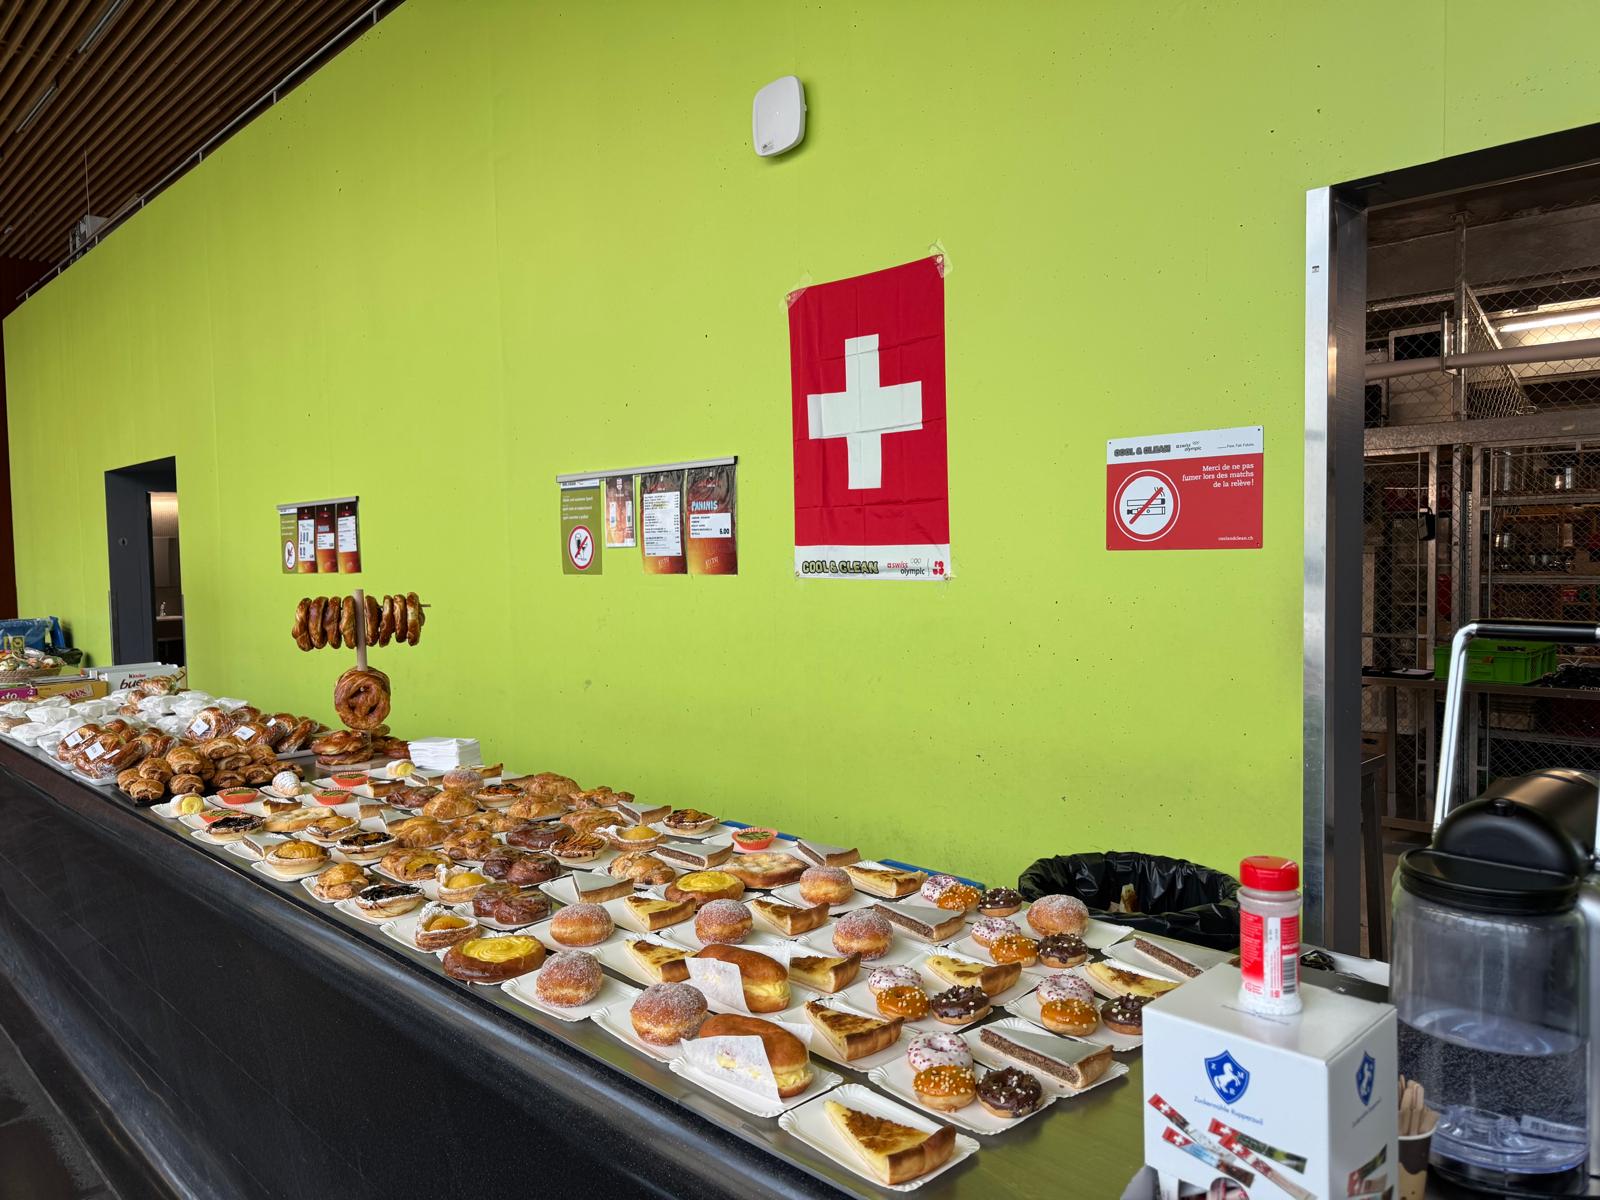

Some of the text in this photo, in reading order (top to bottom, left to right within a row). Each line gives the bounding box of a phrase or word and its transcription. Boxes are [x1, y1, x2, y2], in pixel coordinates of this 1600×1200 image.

[1114, 447, 1135, 457] COOL
[1143, 445, 1171, 455] CLEAN
[1202, 464, 1220, 472] Merci
[1242, 463, 1254, 471] pas
[1230, 471, 1254, 479] matchs
[691, 500, 718, 512] PANINIS
[802, 560, 830, 574] COOL
[838, 560, 879, 574] CLEAN
[900, 568, 925, 576] olympic
[119, 678, 144, 690] bue
